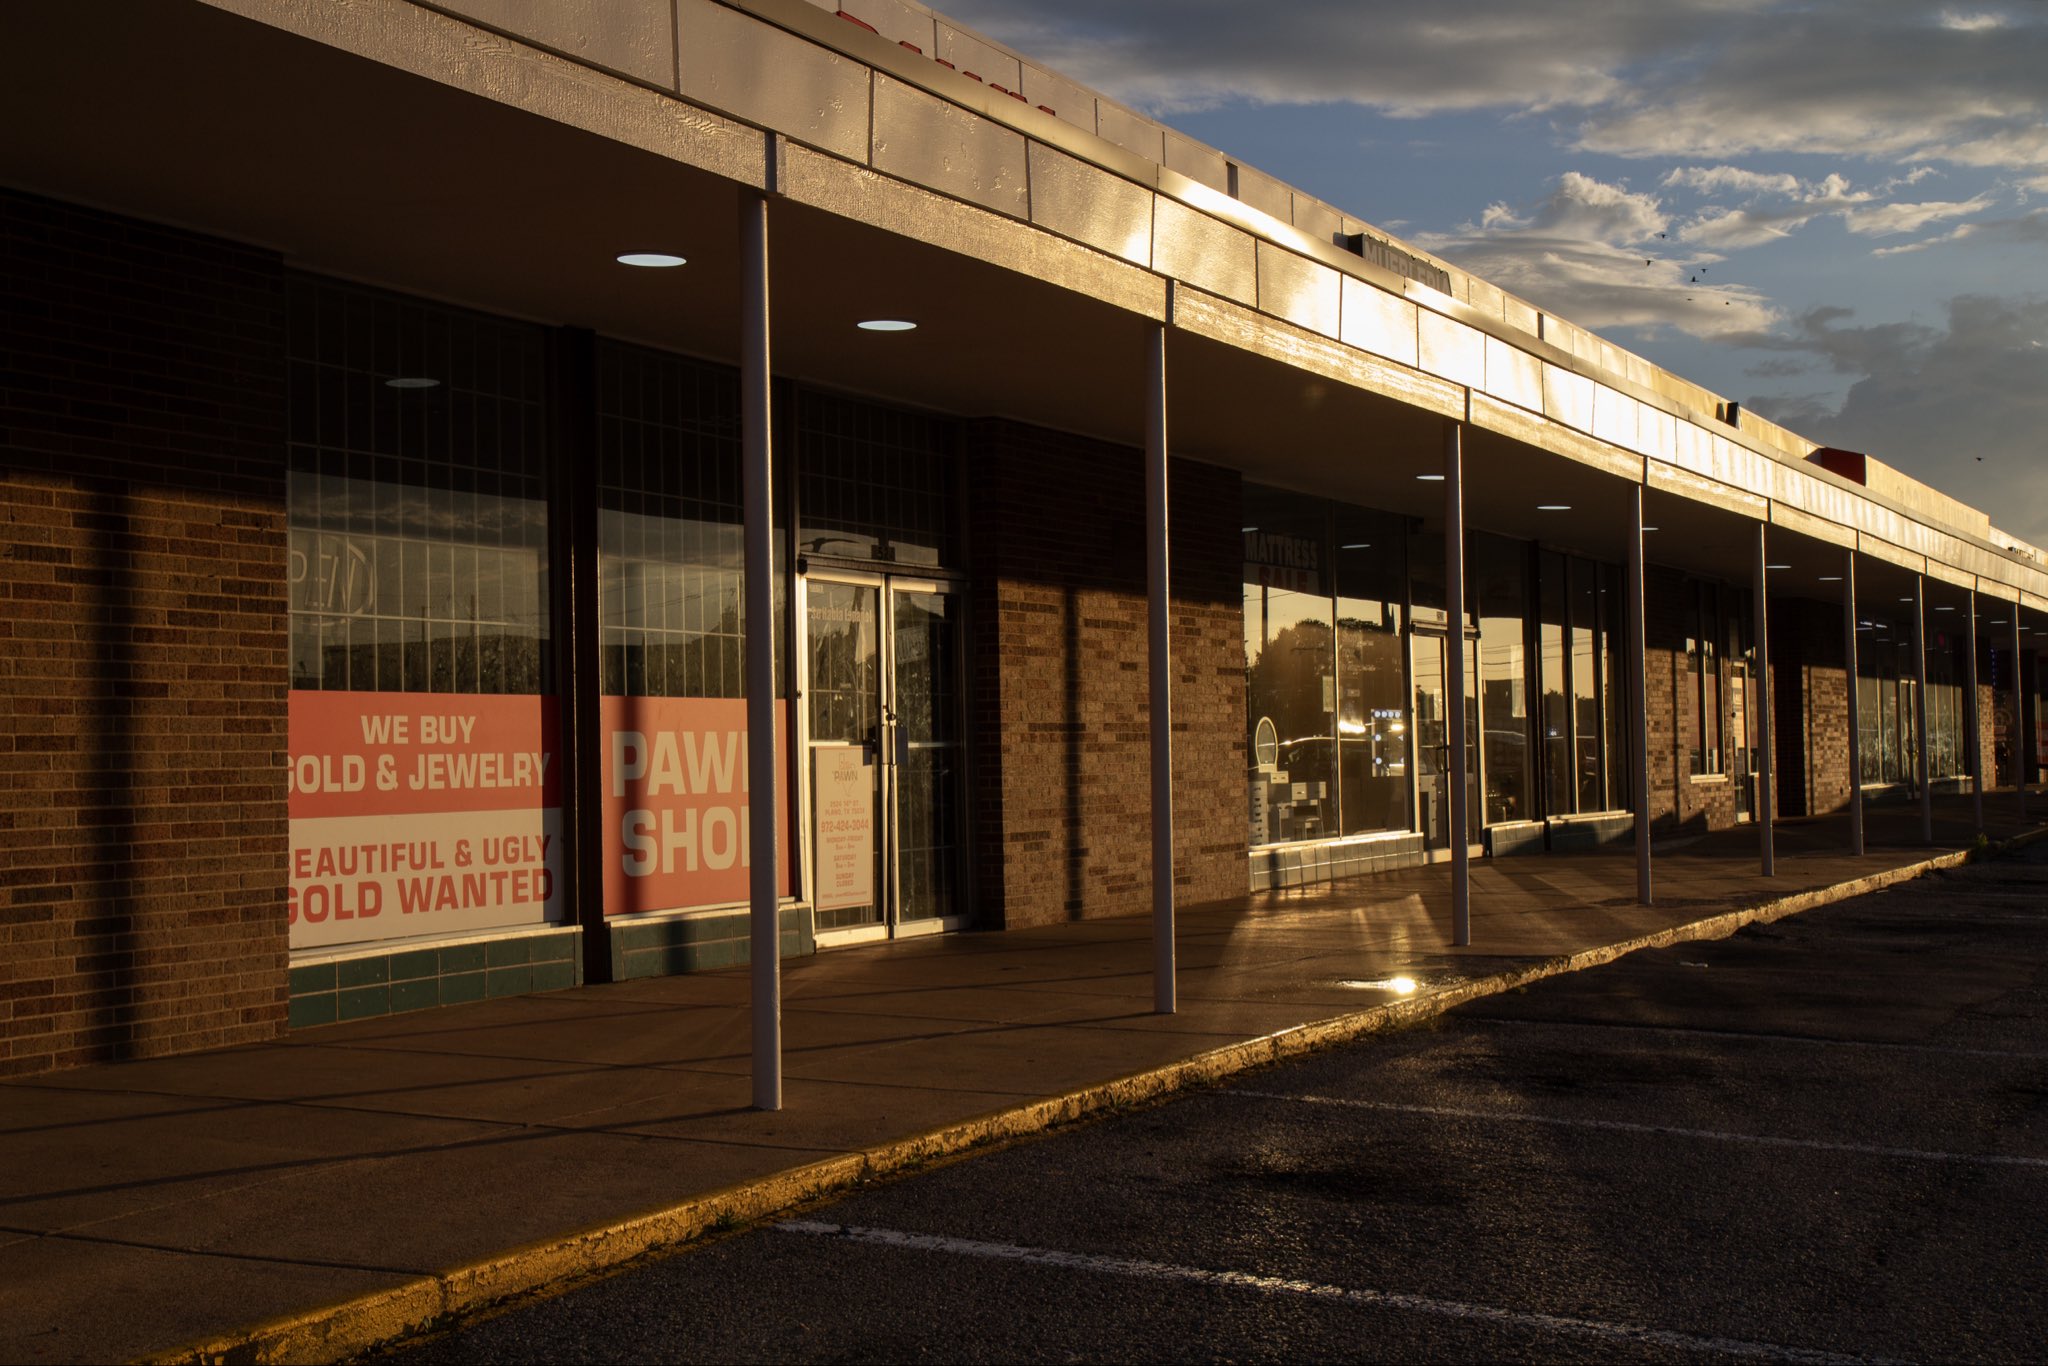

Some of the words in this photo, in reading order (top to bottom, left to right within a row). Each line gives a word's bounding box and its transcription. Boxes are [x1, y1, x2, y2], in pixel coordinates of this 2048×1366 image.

[1244, 531, 1318, 570] MATTRESS
[290, 550, 356, 609] PEN
[361, 715, 409, 744] WE
[420, 715, 476, 744] BUY
[376, 754, 398, 791] &
[409, 752, 551, 791] JEWELRY
[612, 731, 749, 797] PAW
[834, 770, 858, 782] PAWN
[821, 818, 869, 833] 972-424-3044
[288, 841, 444, 879] EAUTIFUL
[454, 839, 472, 867] &
[483, 834, 552, 866] UGLY
[397, 868, 553, 915] WANTED
